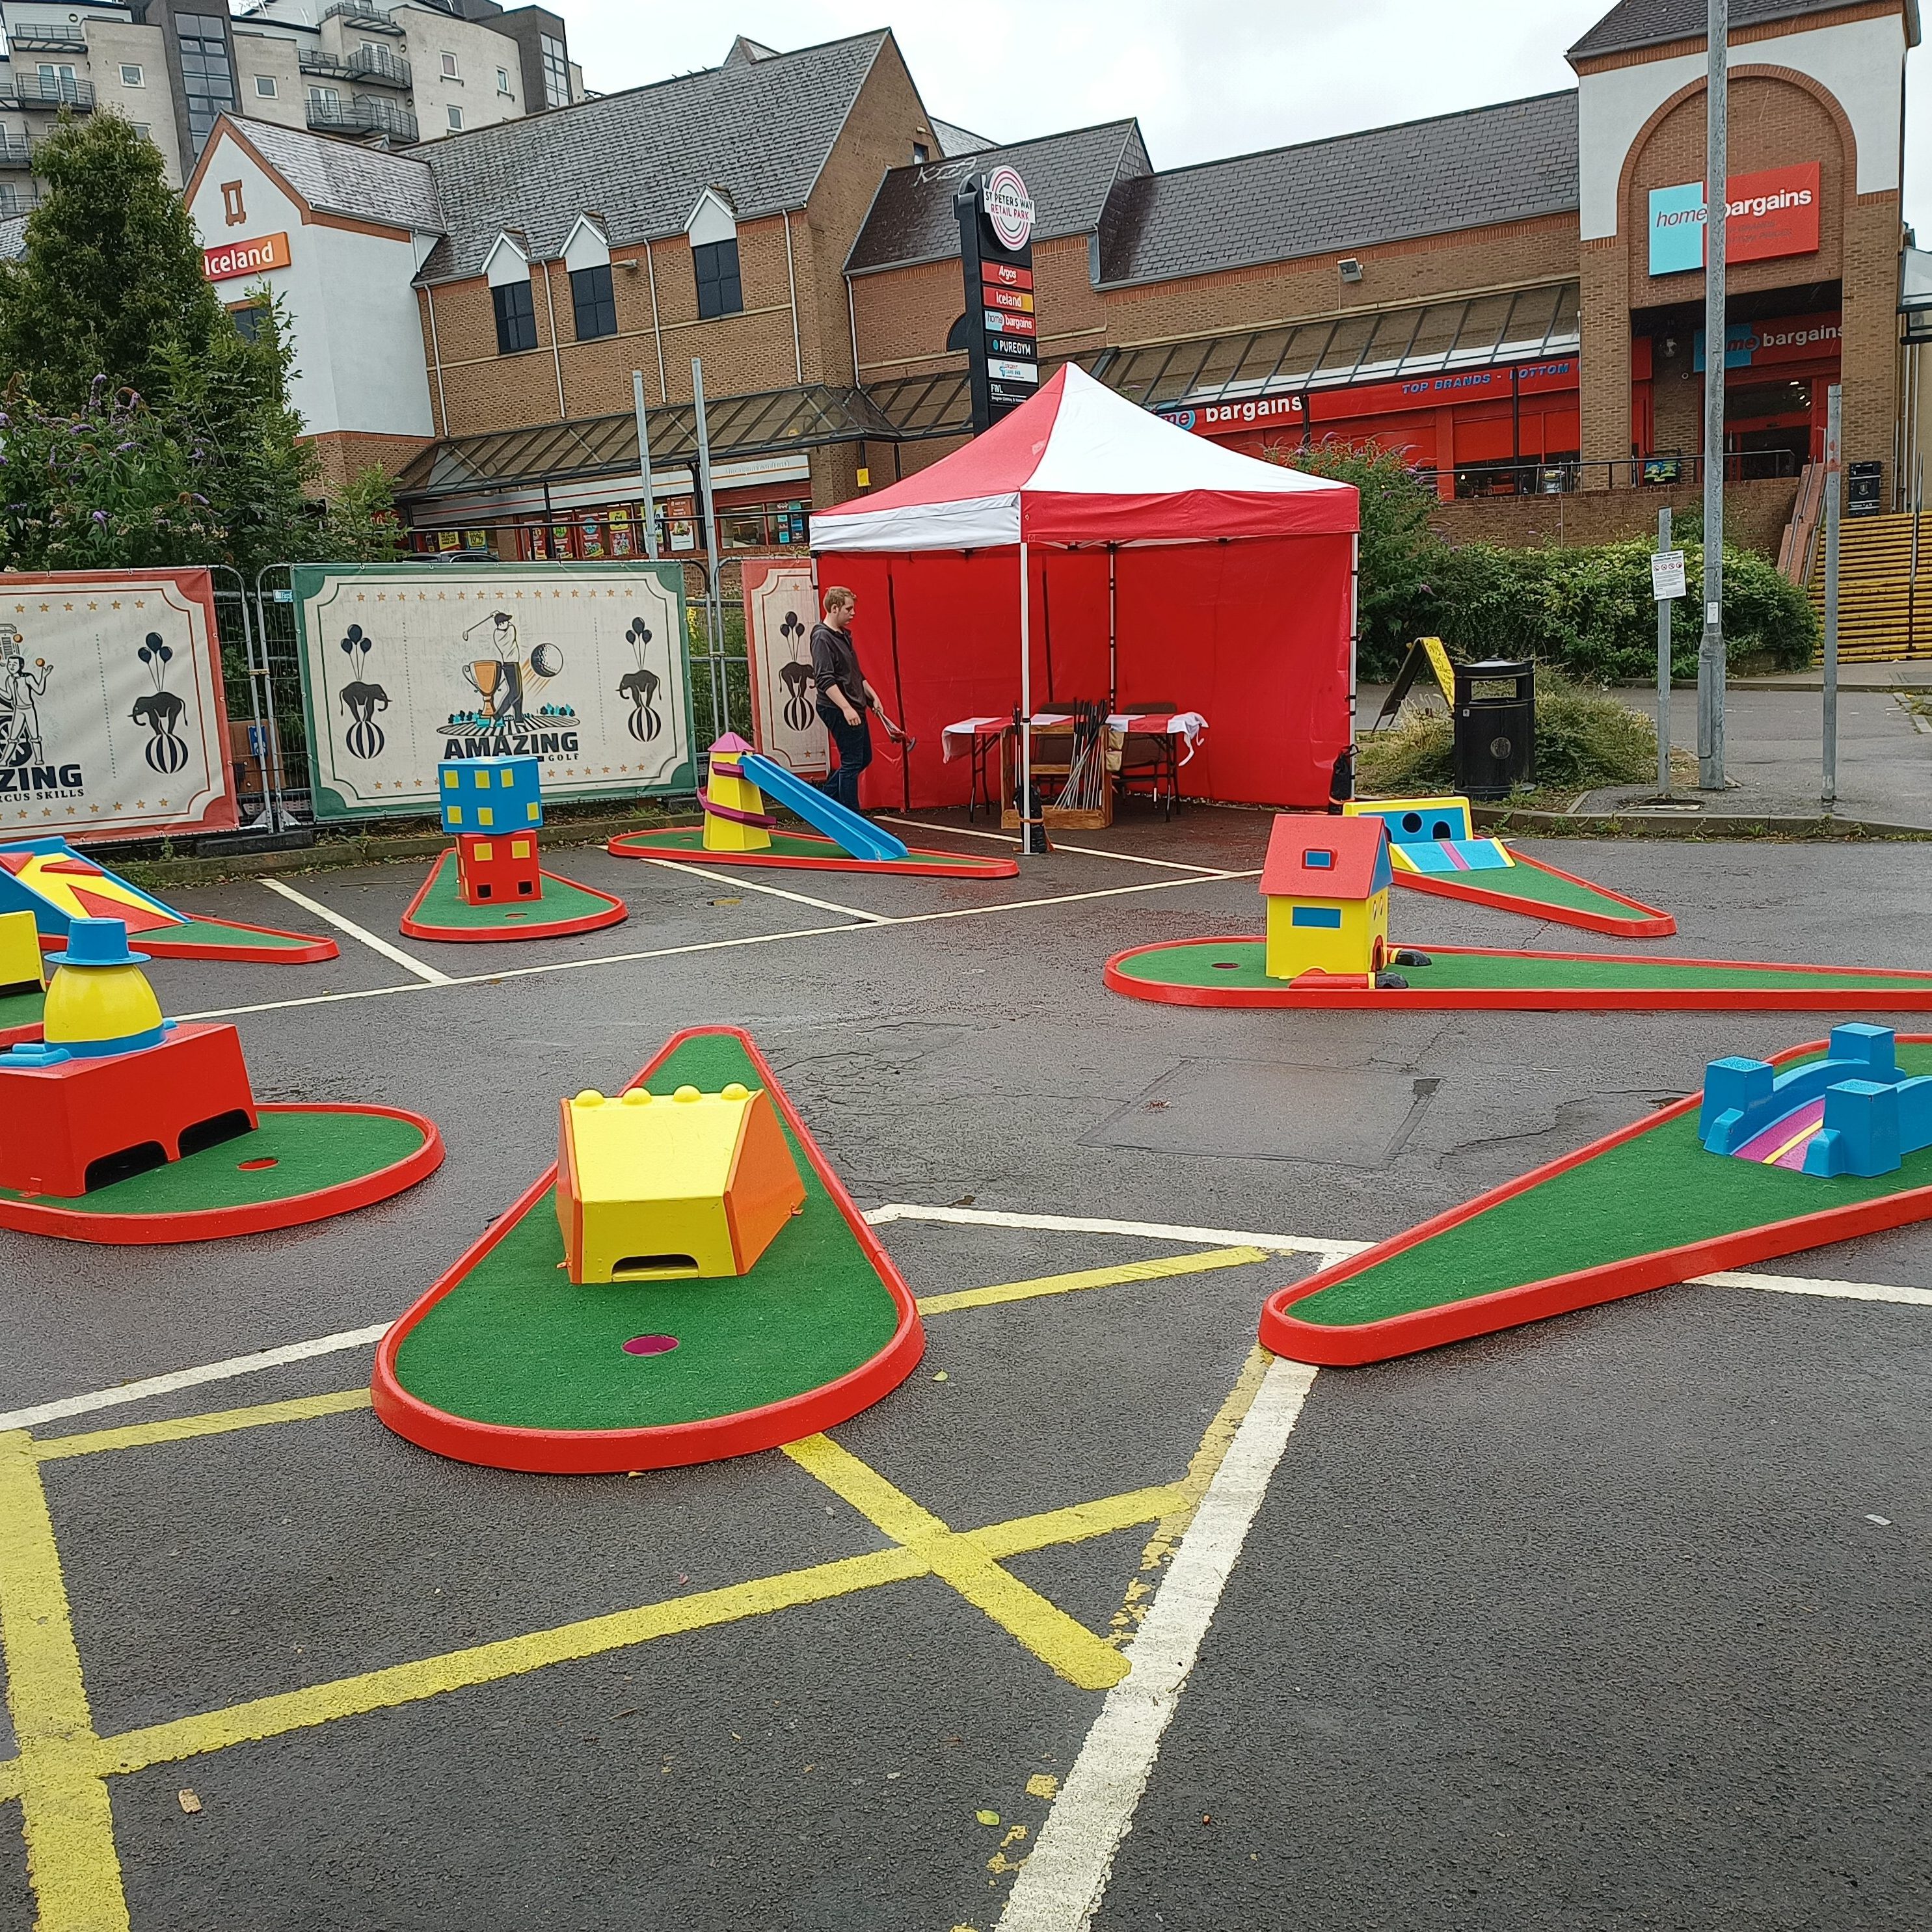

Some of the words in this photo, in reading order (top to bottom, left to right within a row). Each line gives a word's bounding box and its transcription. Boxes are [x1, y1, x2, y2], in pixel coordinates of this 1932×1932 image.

[986, 191, 992, 201] ST
[1020, 199, 1032, 210] WAY
[991, 204, 1012, 217] RETAIL
[1014, 209, 1029, 221] PARK
[1656, 208, 1707, 228] home
[204, 241, 274, 276] Iceland
[999, 265, 1016, 280] Argos
[995, 291, 1021, 307] Iceland
[987, 313, 1002, 323] home
[1004, 314, 1032, 330] bargains
[999, 340, 1031, 355] PUREGYM
[1402, 382, 1429, 394] TOP
[1434, 373, 1491, 390] BRANDS
[1206, 396, 1302, 423] bargains
[444, 732, 579, 760] AMAZING
[548, 753, 579, 762] GOLF
[36, 789, 84, 800] SKILLS
